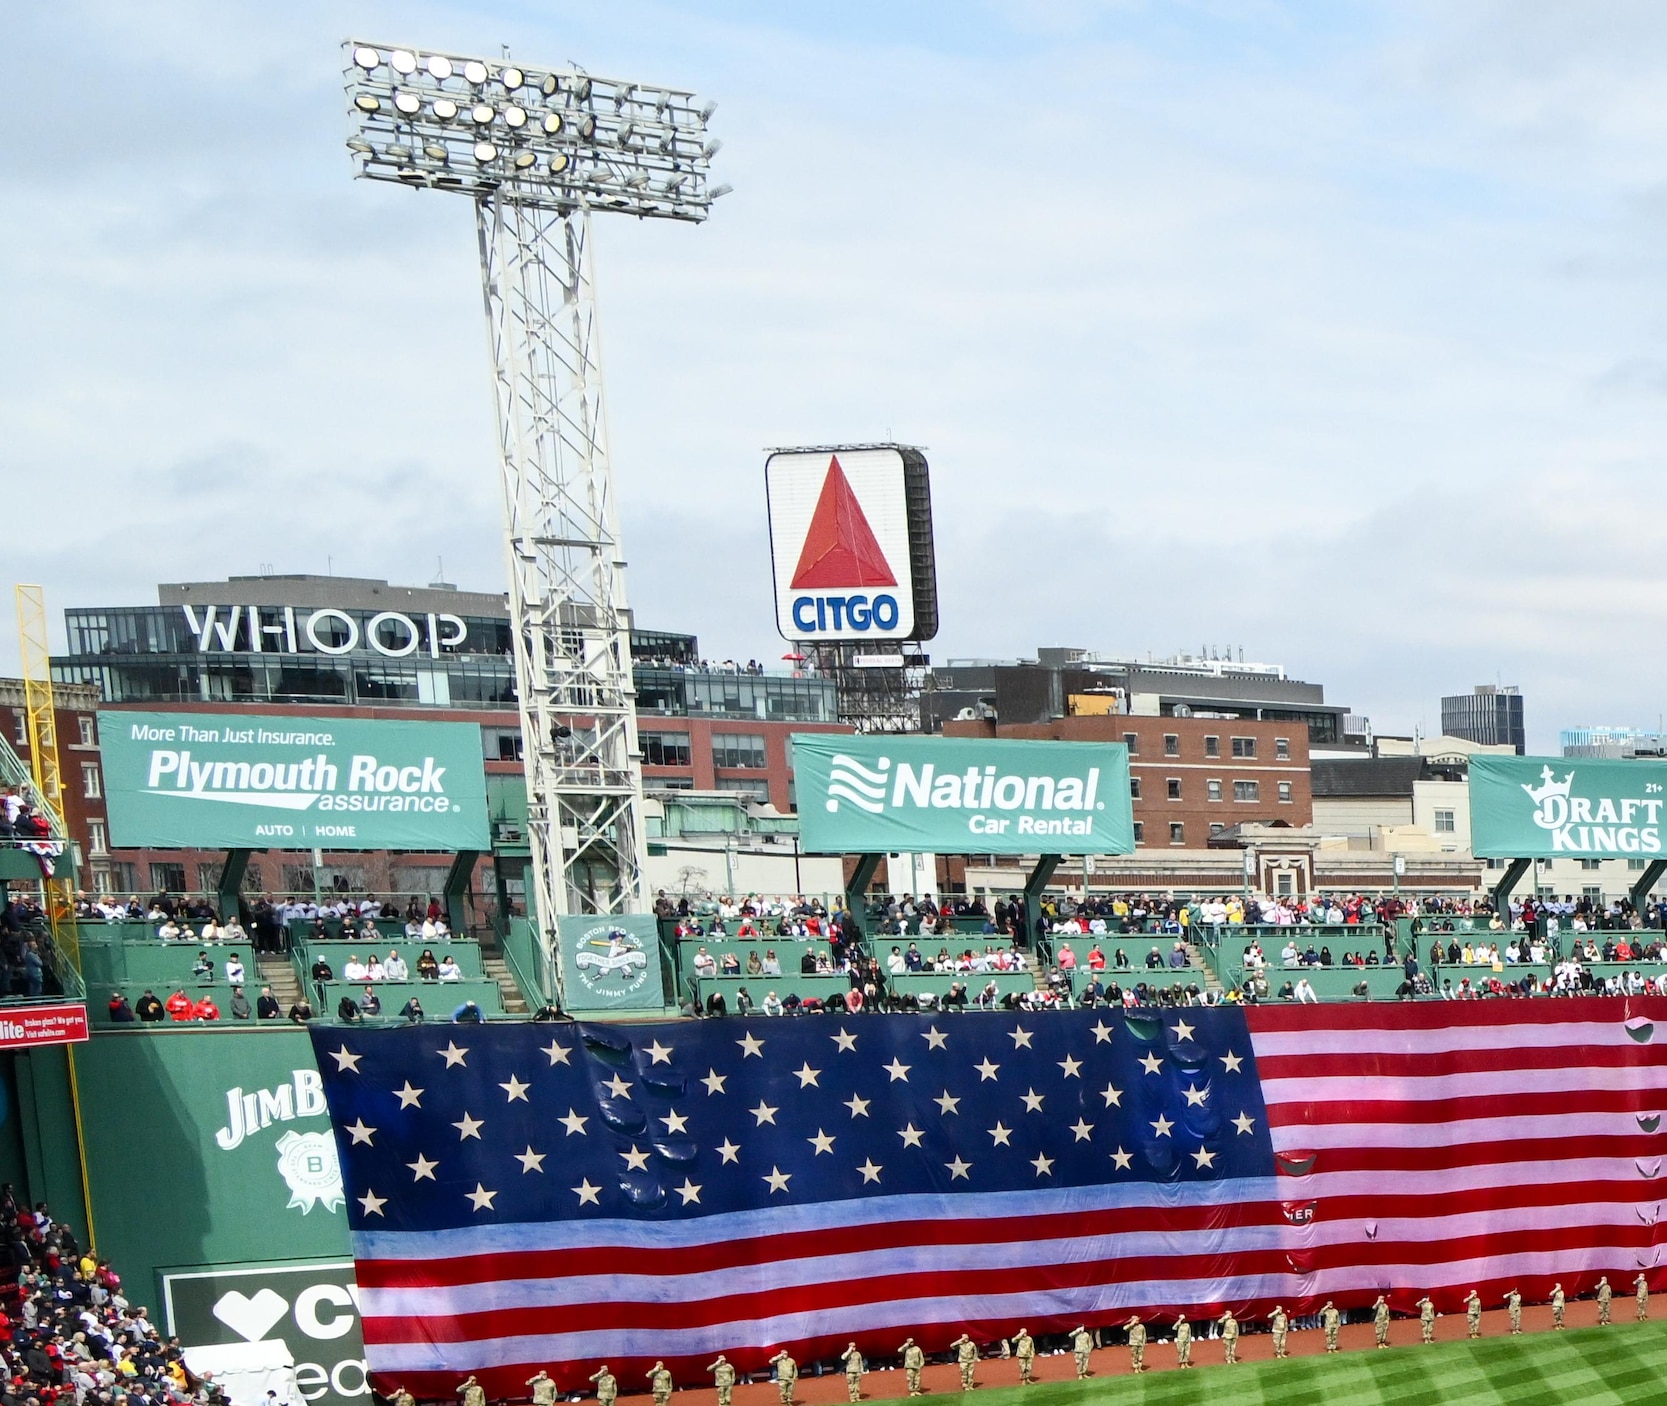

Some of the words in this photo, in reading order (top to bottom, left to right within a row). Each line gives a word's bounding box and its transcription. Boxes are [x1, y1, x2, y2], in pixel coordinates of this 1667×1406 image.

[792, 594, 899, 632] CITGO
[183, 605, 467, 658] WHOOP
[131, 724, 175, 743] More
[178, 726, 219, 743] Than
[222, 727, 254, 744] Just
[257, 729, 336, 747] Insurance.
[148, 751, 338, 793] Plymouth
[347, 755, 447, 794] Rock
[892, 762, 1100, 812] National
[1645, 783, 1664, 793] 21+
[318, 792, 450, 813] assurance
[1532, 794, 1664, 830] DRAFT
[255, 825, 294, 837] AUTO
[315, 826, 357, 838] HOME
[968, 815, 1009, 835] Car
[1017, 815, 1093, 836] Rental
[1551, 823, 1663, 853] KINGS
[576, 926, 606, 950] BOSTON
[628, 932, 644, 949] SOX
[578, 972, 594, 990] THE
[596, 988, 626, 997] JIMMY
[629, 970, 648, 992] FUND
[0, 1020, 25, 1040] lite
[216, 1082, 296, 1151] JIM
[307, 1156, 323, 1173] B
